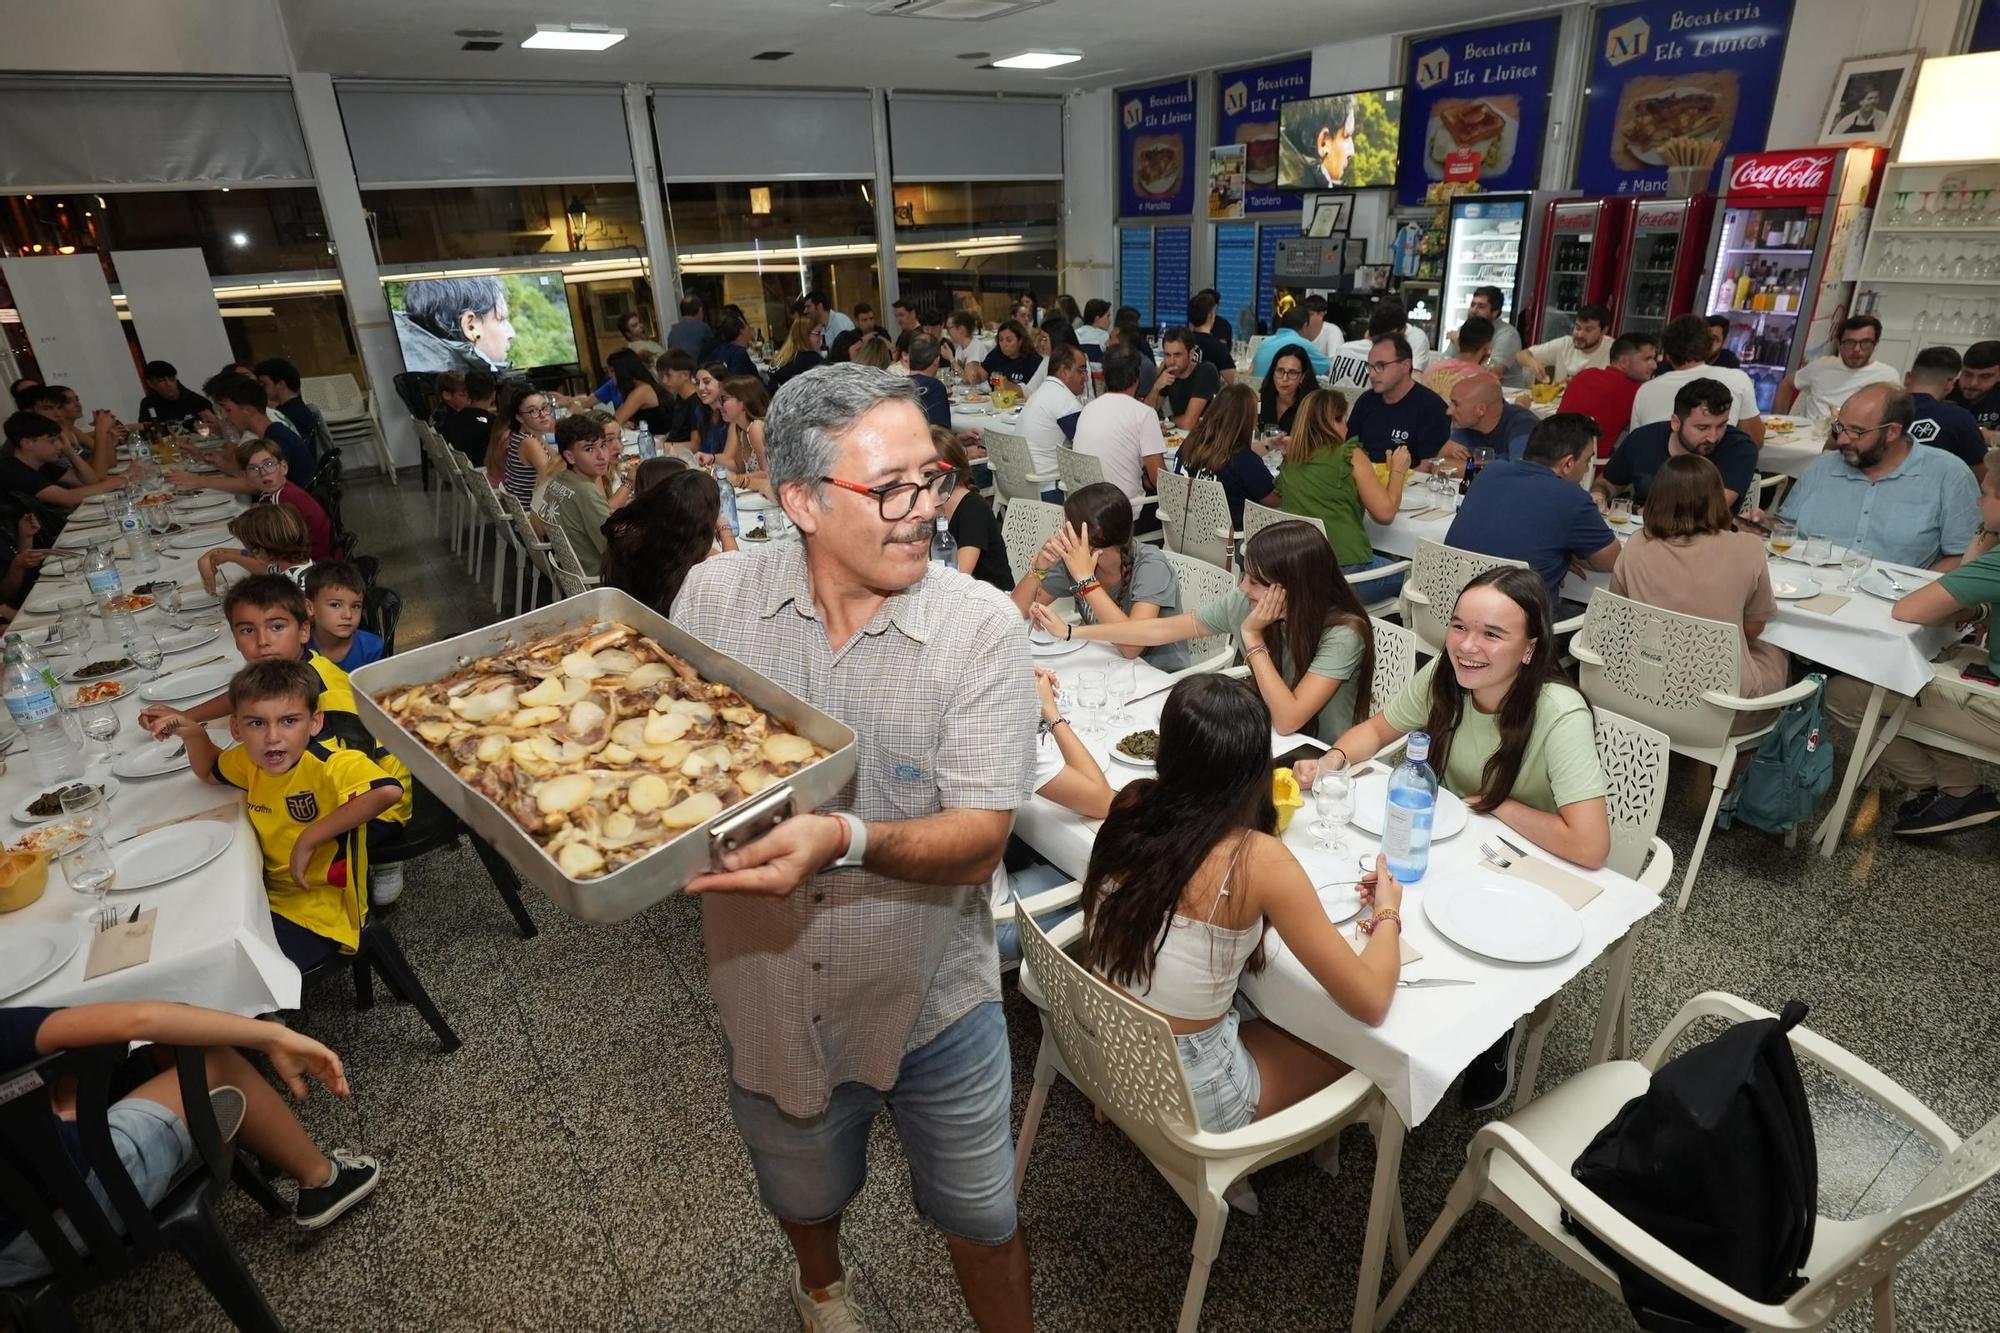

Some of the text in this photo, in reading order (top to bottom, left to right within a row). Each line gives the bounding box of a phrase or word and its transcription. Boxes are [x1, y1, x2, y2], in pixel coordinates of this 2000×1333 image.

[1668, 3, 1760, 31] Bocateria
[1463, 38, 1532, 60] Bocateria
[1610, 33, 1647, 58] M
[1655, 42, 1683, 62] Els
[1420, 61, 1446, 82] M
[1454, 69, 1476, 86] Els
[1251, 98, 1267, 113] Els
[1730, 156, 1834, 190] Coca-Cola
